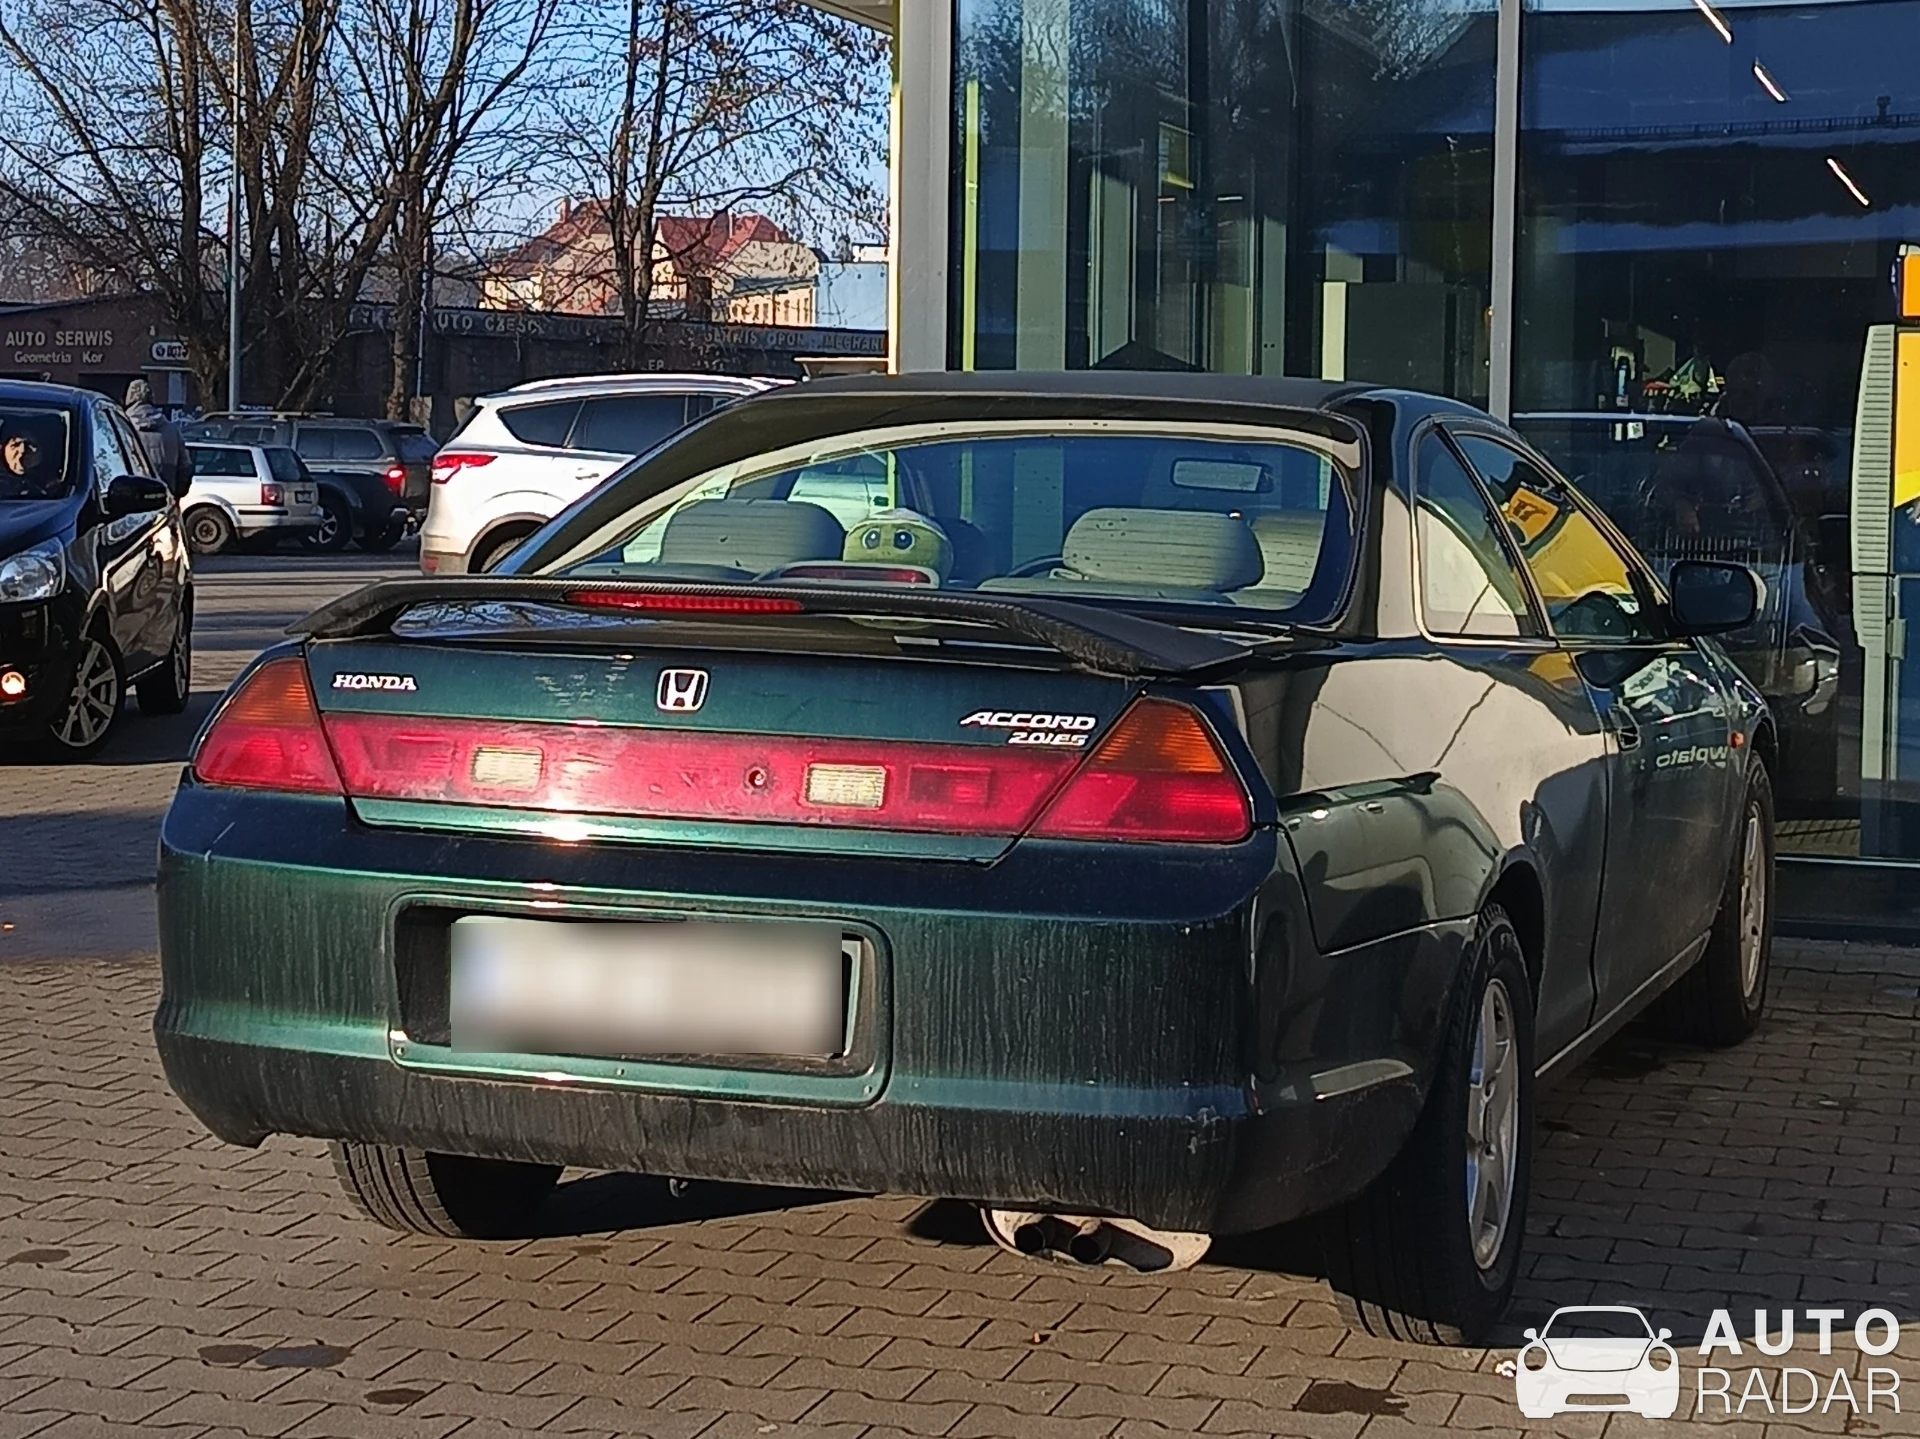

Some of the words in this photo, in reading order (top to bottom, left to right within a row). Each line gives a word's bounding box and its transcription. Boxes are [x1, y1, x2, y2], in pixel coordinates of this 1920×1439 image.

[5, 331, 45, 347] AUTO
[55, 330, 113, 347] SERWIS
[15, 350, 72, 363] Geometria
[332, 674, 417, 691] HONDA
[960, 711, 1096, 730] ACCORD
